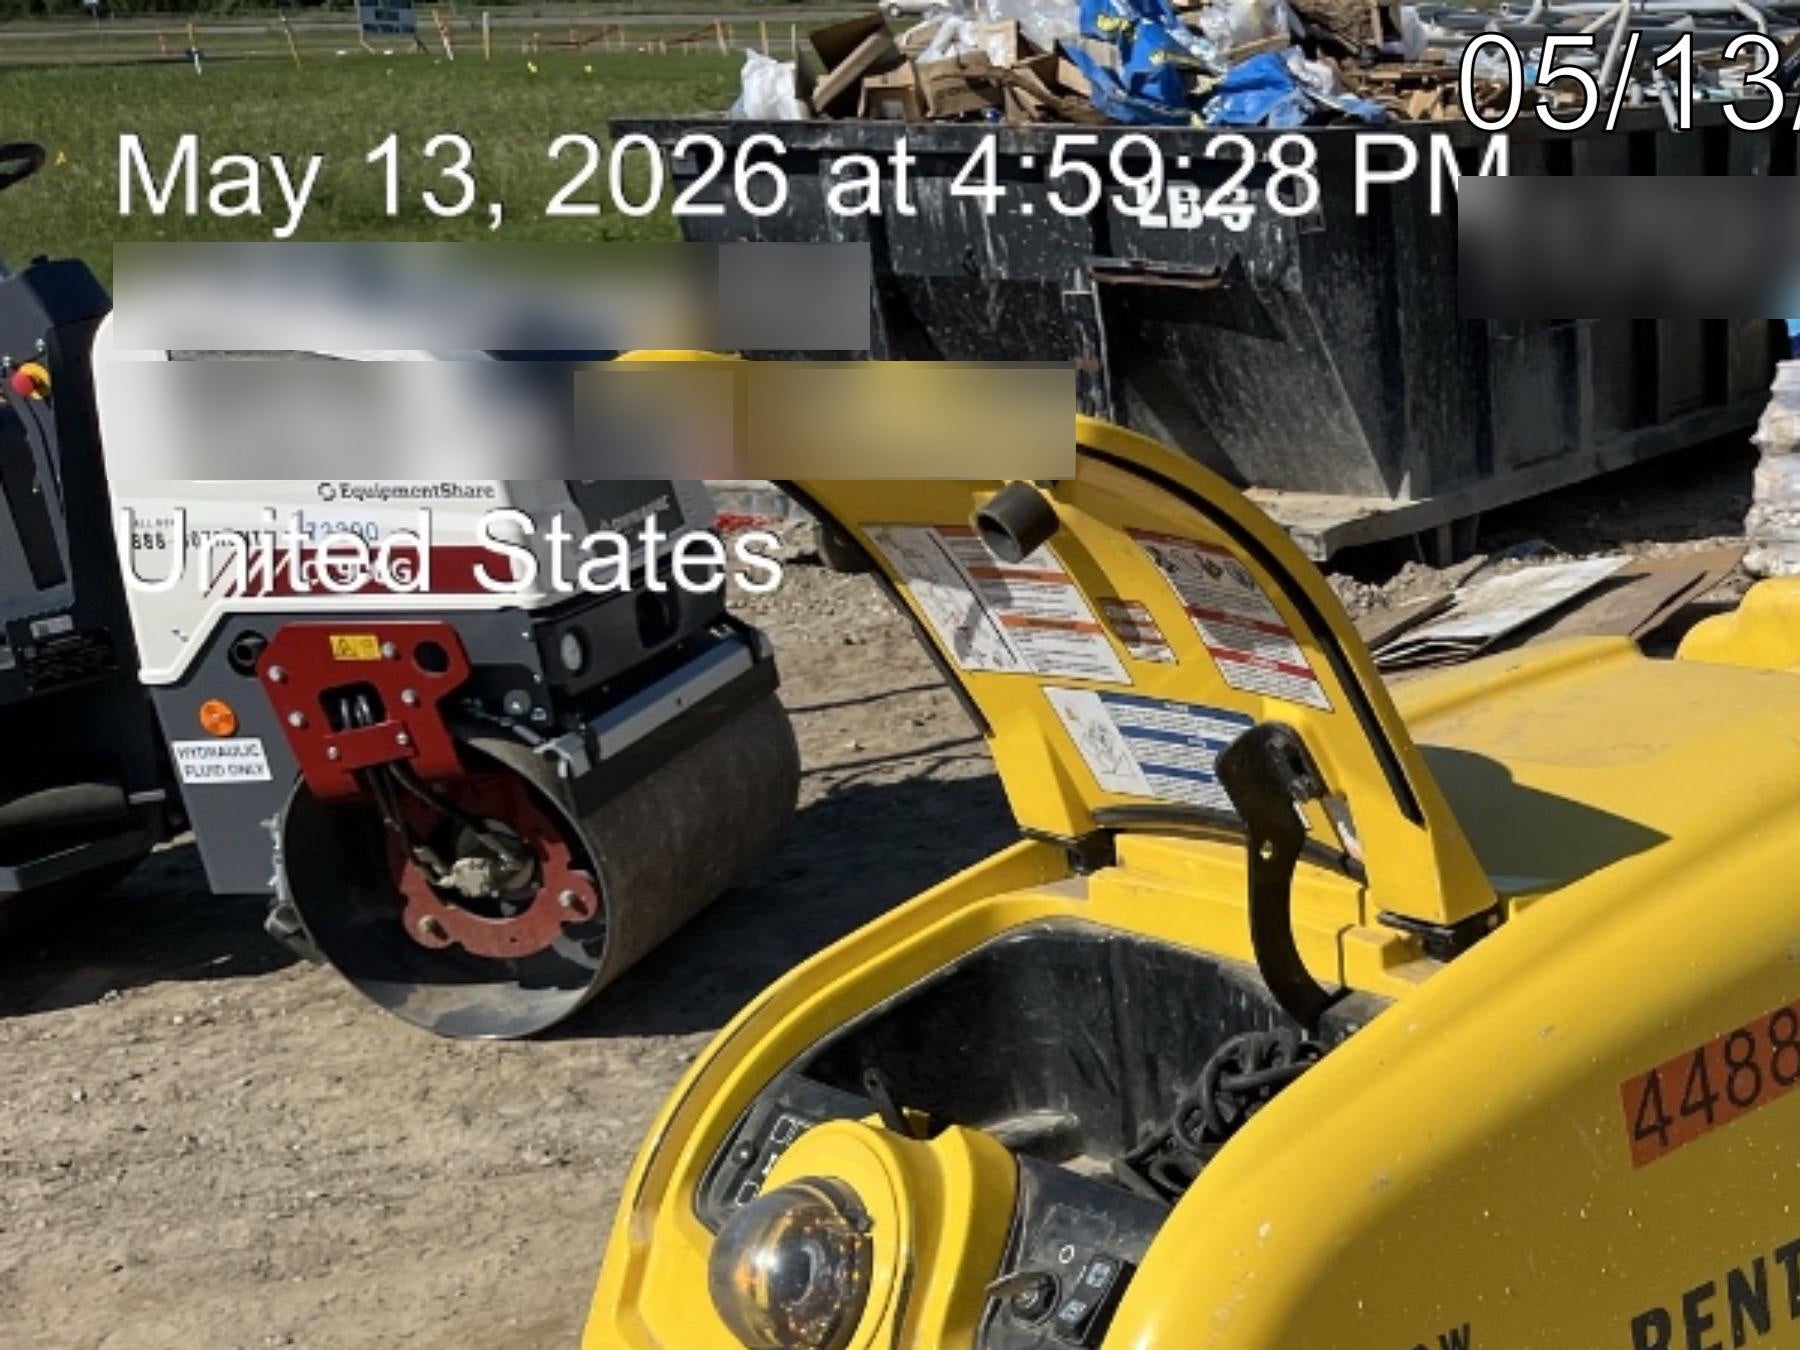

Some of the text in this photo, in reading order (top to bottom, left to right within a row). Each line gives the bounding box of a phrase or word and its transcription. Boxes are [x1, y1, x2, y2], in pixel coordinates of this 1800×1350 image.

[341, 482, 496, 501] EquipmentShare
[178, 744, 260, 759] HYDRAULIC
[185, 763, 264, 777] FLUID ONLY
